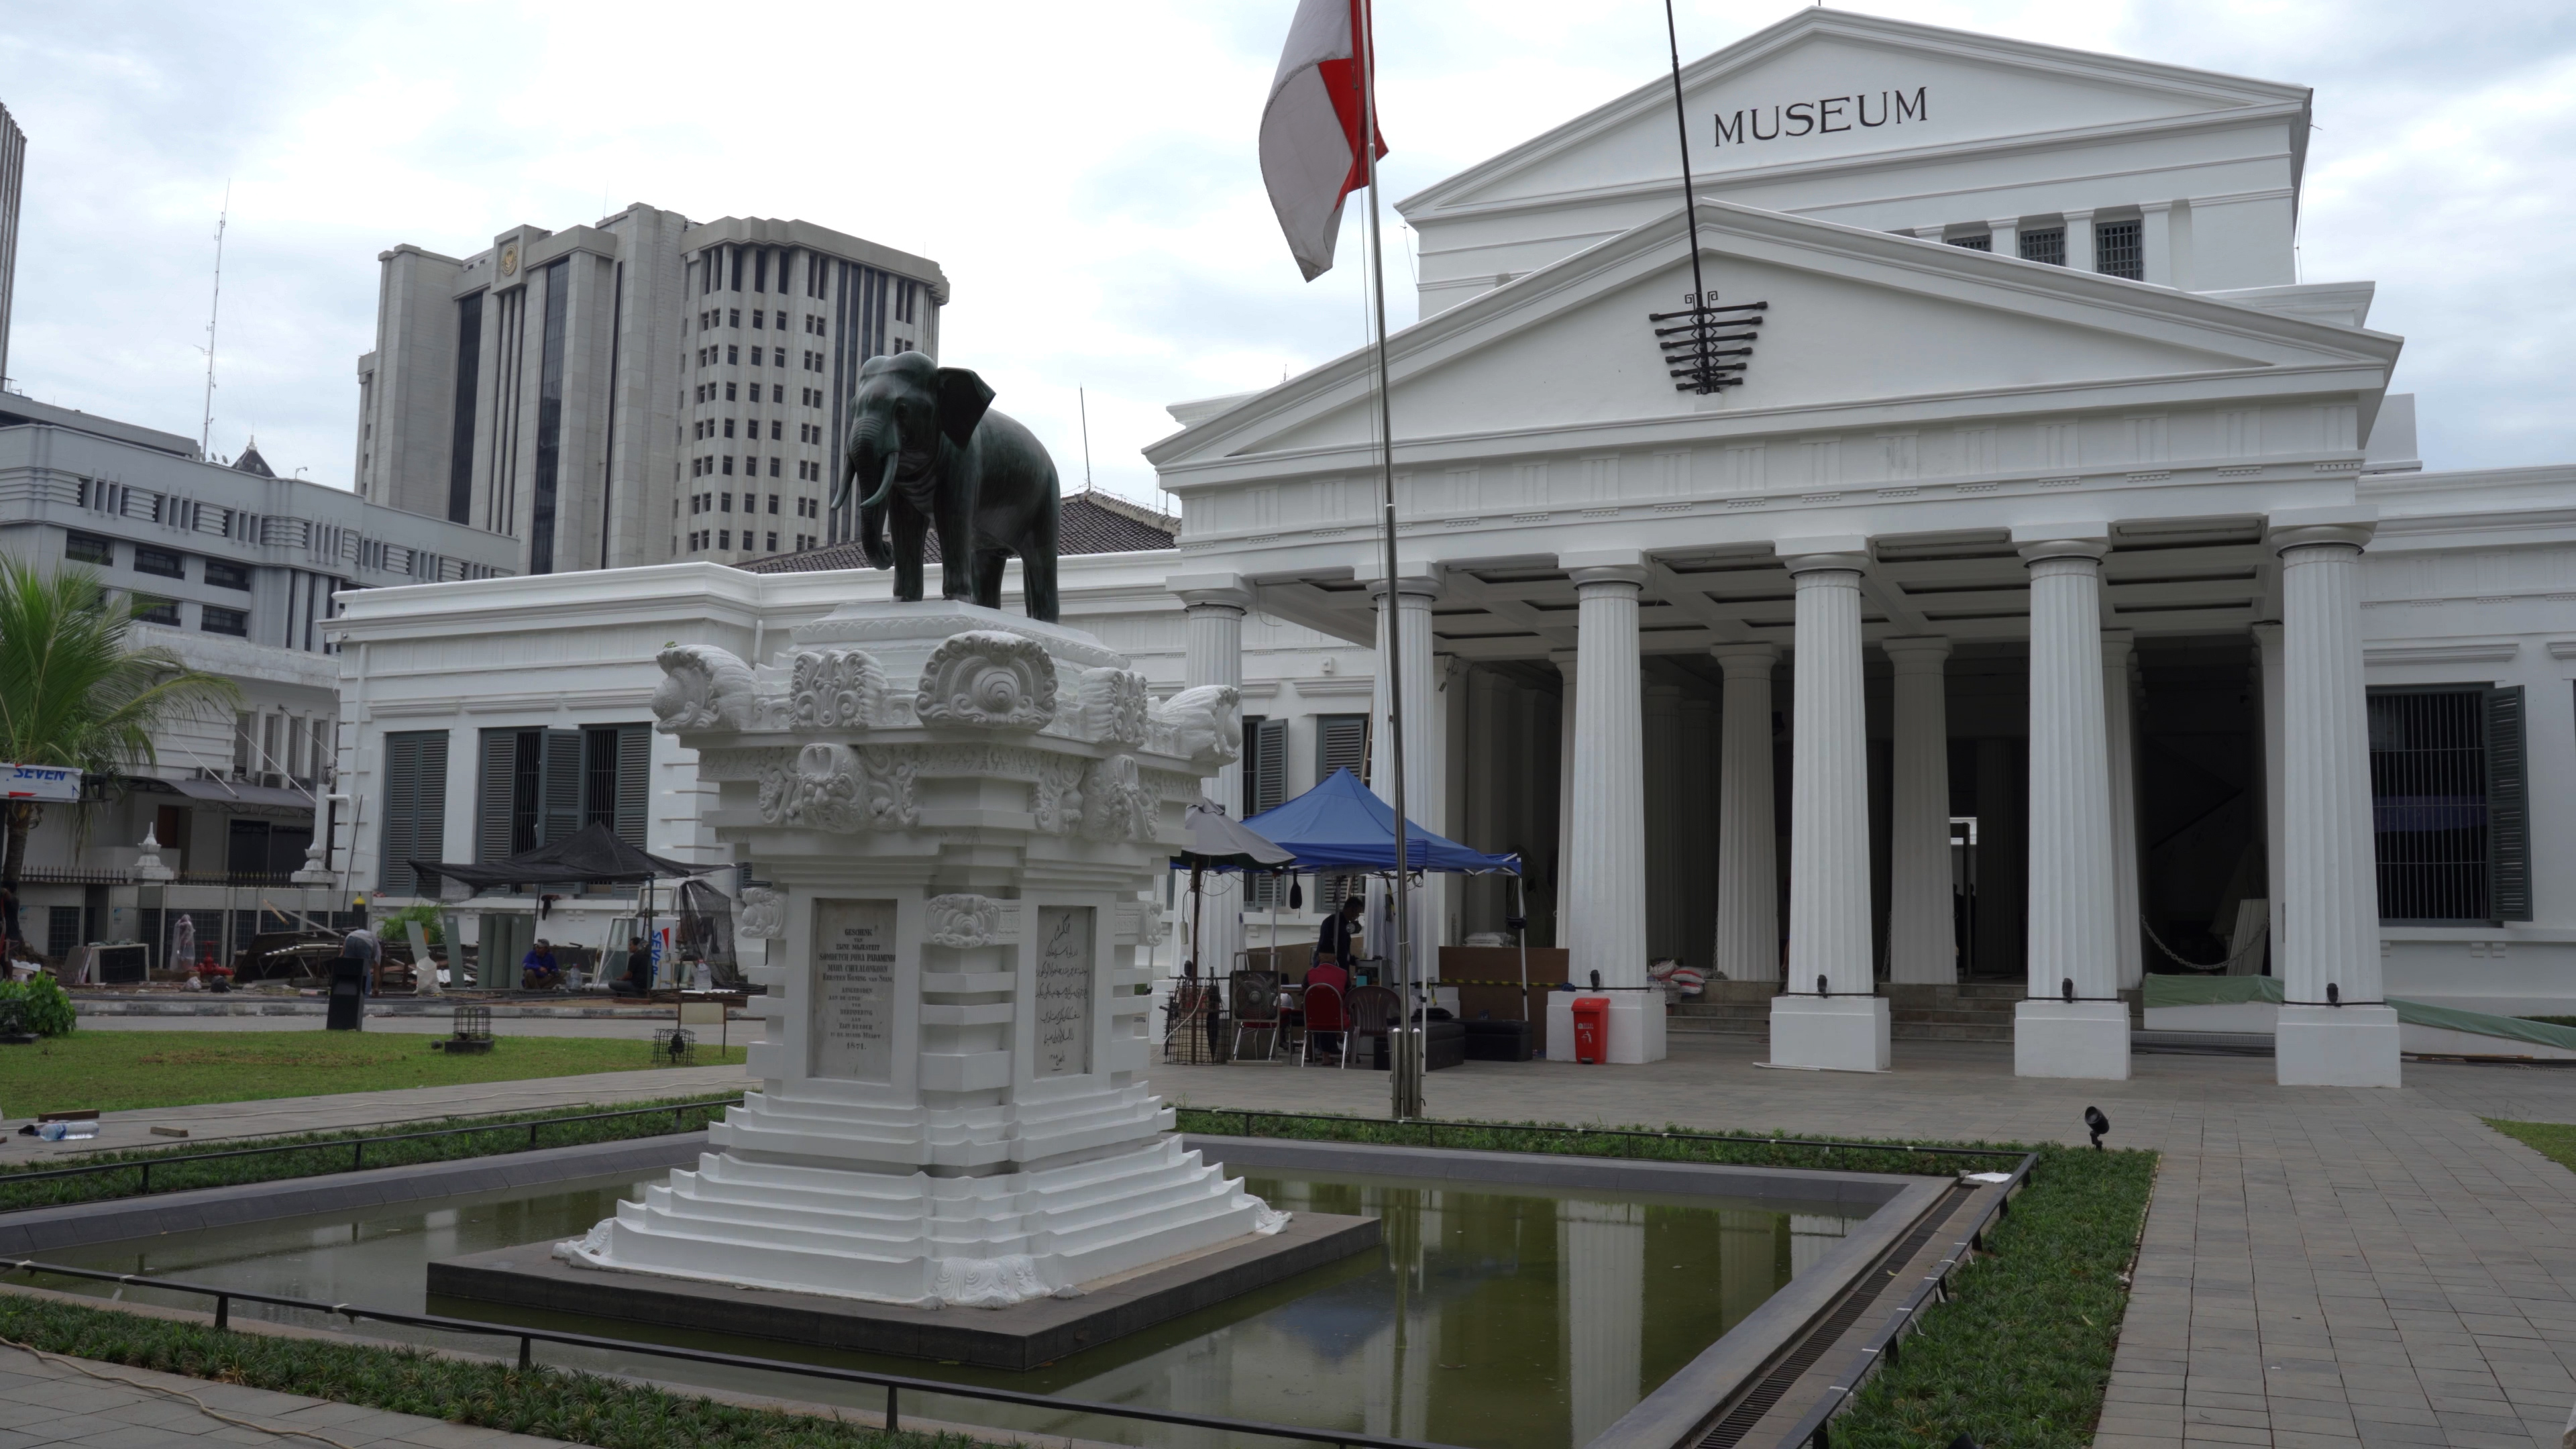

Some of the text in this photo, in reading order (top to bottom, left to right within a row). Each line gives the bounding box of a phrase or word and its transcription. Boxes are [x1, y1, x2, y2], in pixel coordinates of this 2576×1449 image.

[1714, 86, 1927, 147] MUSEUM
[13, 767, 66, 781] SEVEN
[844, 928, 873, 936] GESCHENK
[851, 943, 881, 951] MAJESTEIT
[818, 953, 849, 961] SOMDETCH
[850, 953, 865, 962] PHRA
[822, 972, 847, 981] EERSTEN
[847, 973, 867, 982] KONING
